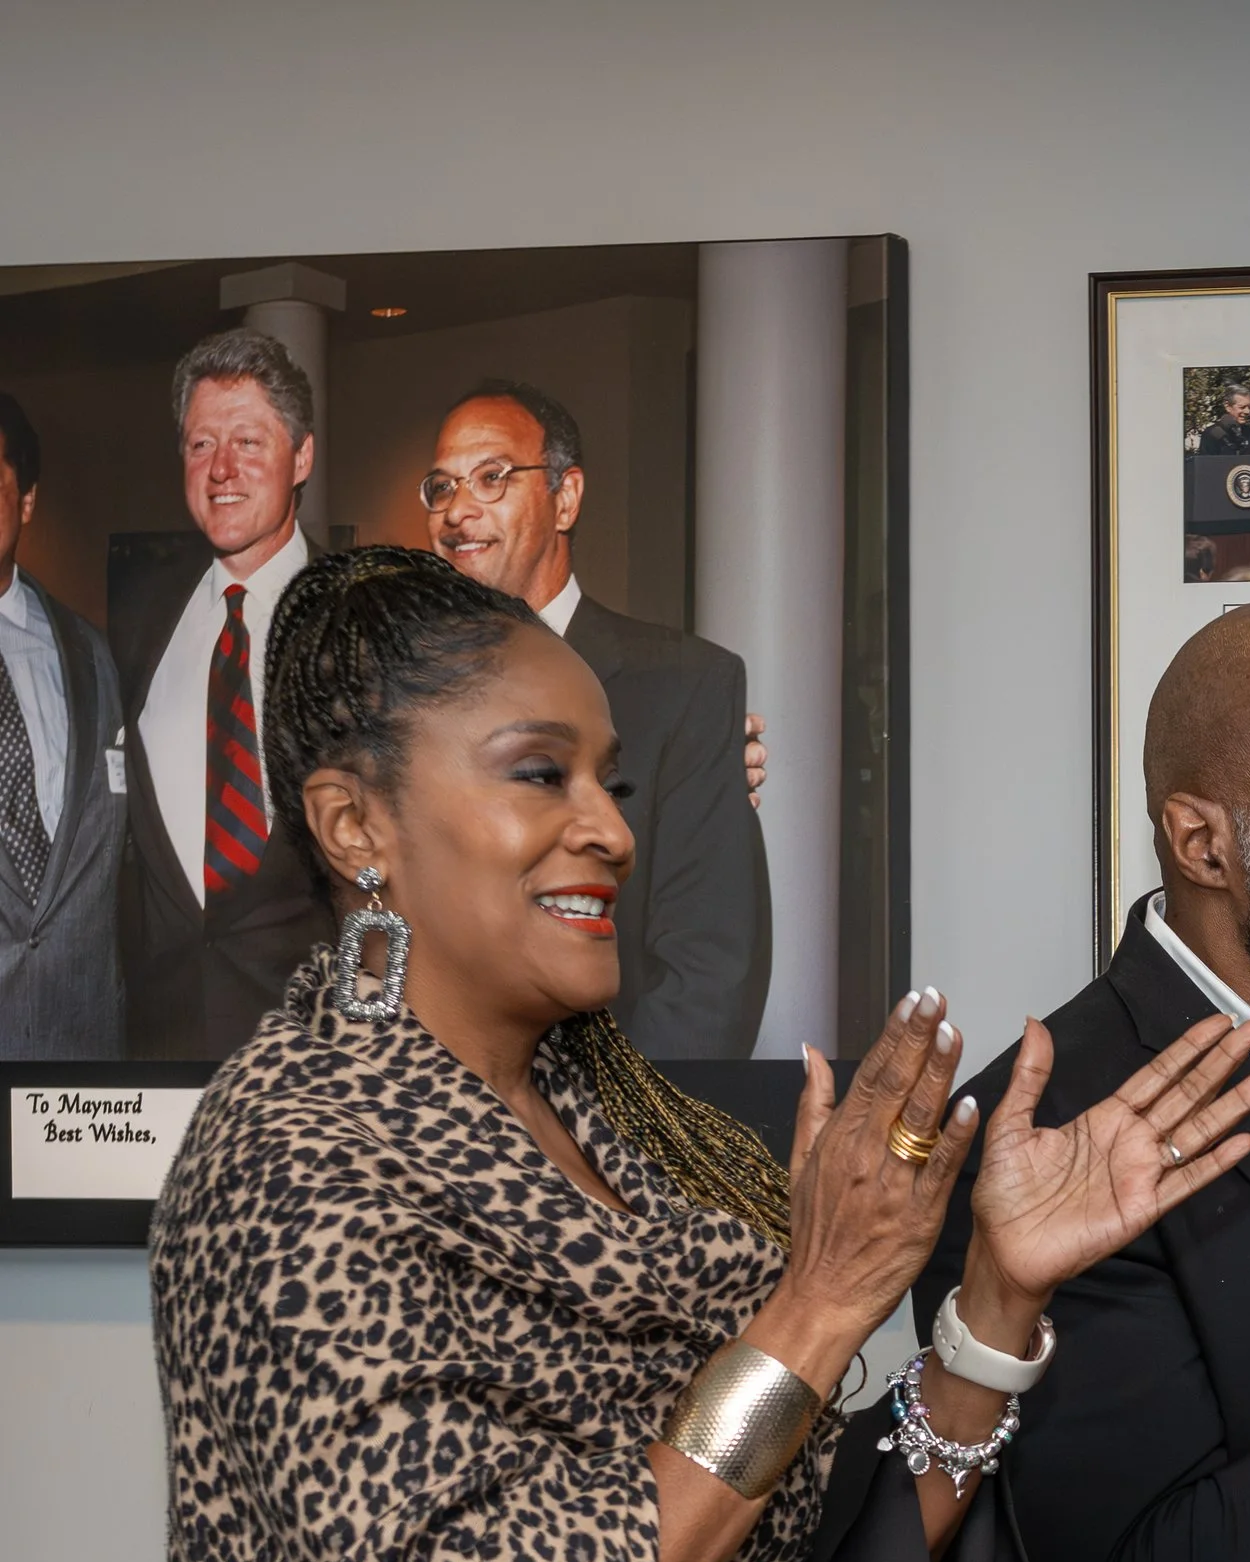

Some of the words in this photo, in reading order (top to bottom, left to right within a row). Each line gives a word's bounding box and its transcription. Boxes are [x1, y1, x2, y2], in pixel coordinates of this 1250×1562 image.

[26, 1093, 50, 1114] To
[57, 1092, 143, 1120] Maynard
[44, 1119, 83, 1143] Best
[88, 1122, 157, 1145] Wishes,
